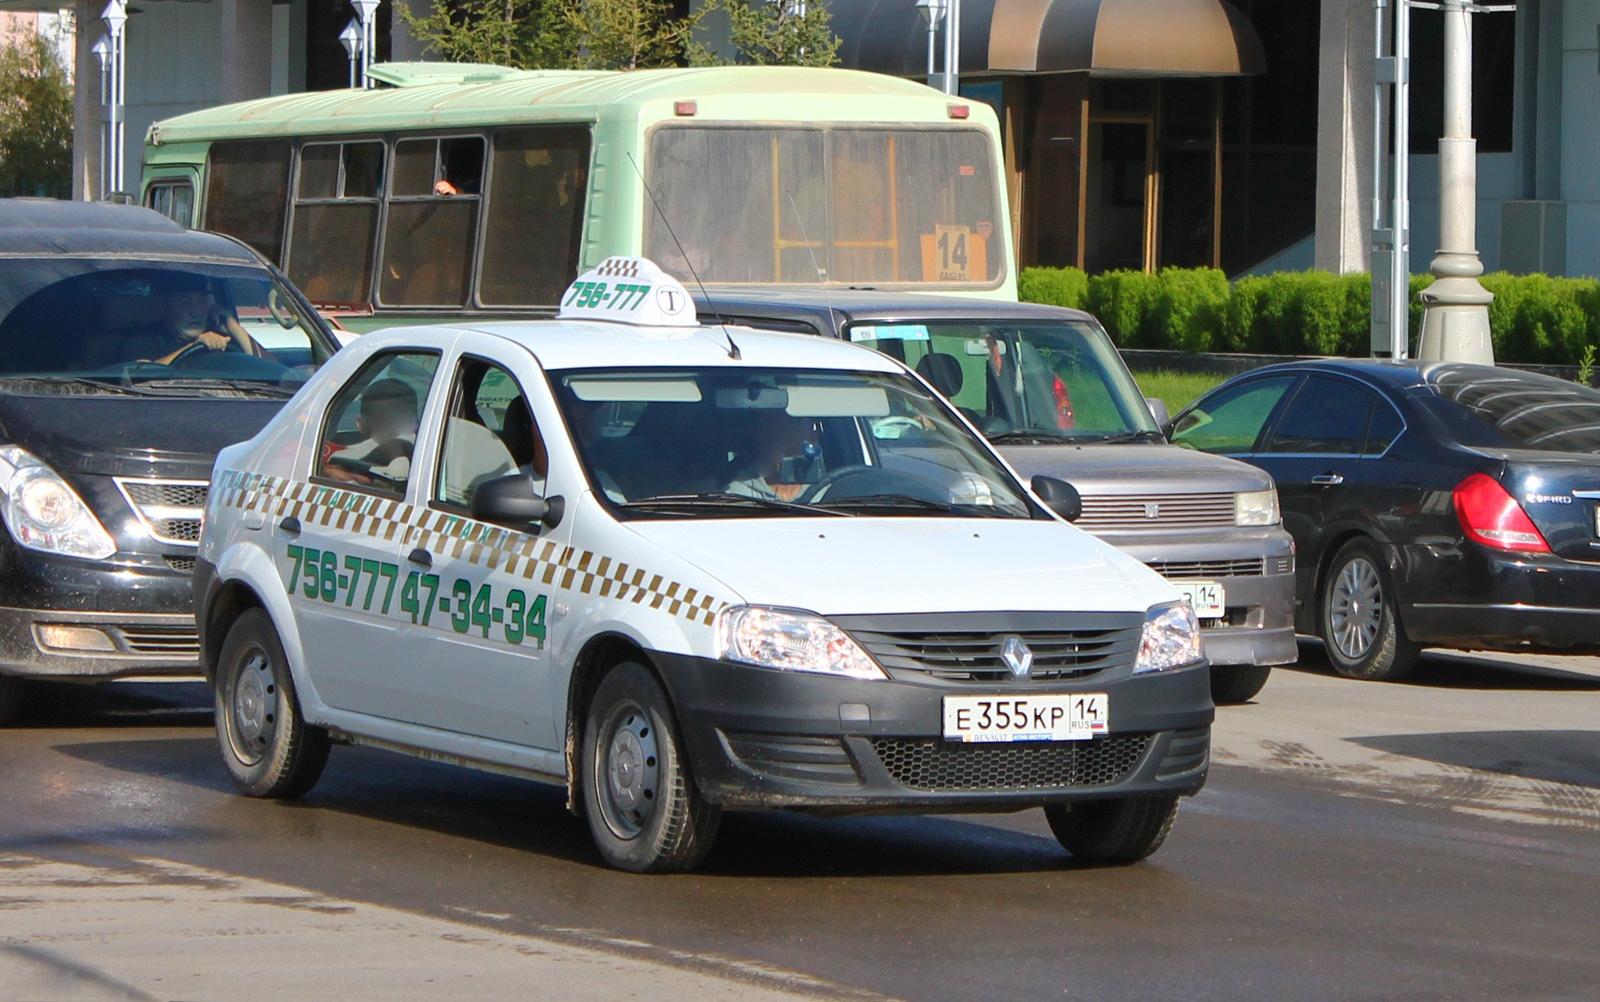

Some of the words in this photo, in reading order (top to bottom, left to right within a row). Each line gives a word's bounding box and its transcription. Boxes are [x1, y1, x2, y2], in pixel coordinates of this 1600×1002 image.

[937, 232, 967, 271] 14
[288, 544, 399, 615] 756-777
[1199, 586, 1216, 603] 14
[401, 571, 548, 650] 47-34-34
[1075, 698, 1098, 720] 14
[1071, 720, 1090, 729] RUS
